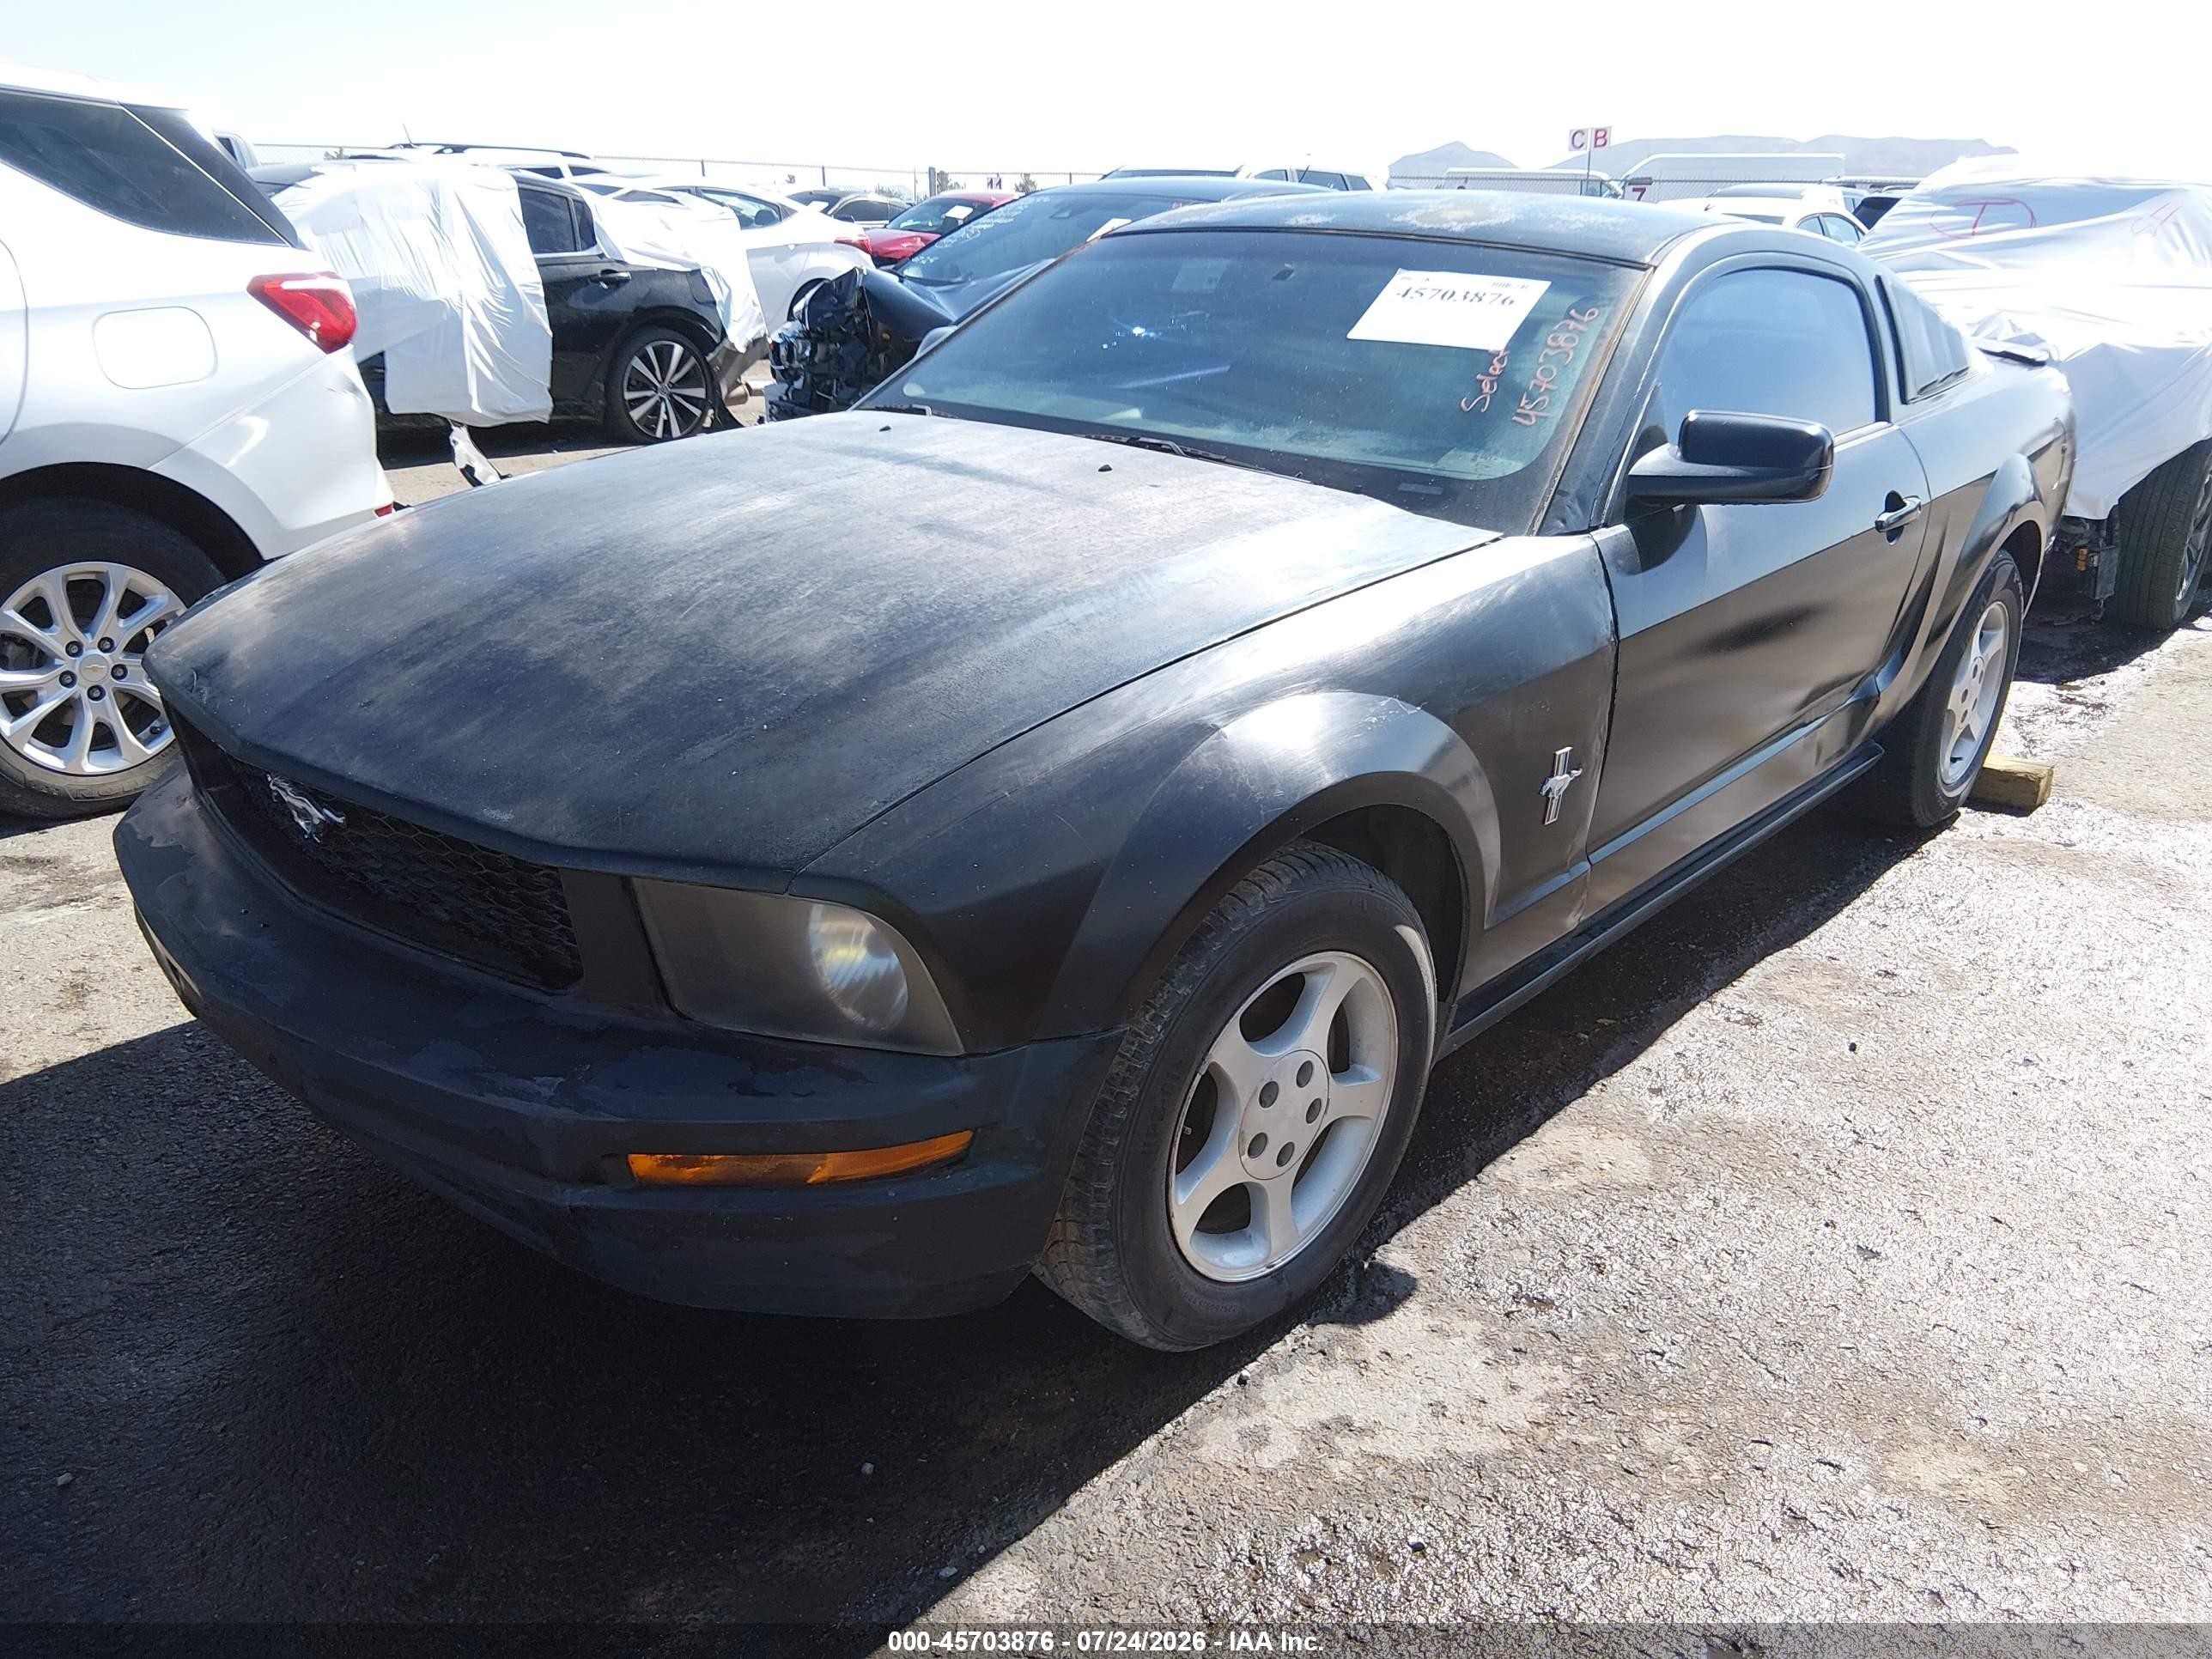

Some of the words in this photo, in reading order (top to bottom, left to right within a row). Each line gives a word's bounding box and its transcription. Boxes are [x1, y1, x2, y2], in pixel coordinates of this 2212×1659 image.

[1571, 130, 1585, 149] C
[1594, 129, 1608, 149] B
[1632, 186, 1647, 202] 7
[1395, 286, 1516, 307] 45703876
[1511, 307, 1600, 427] 45703876
